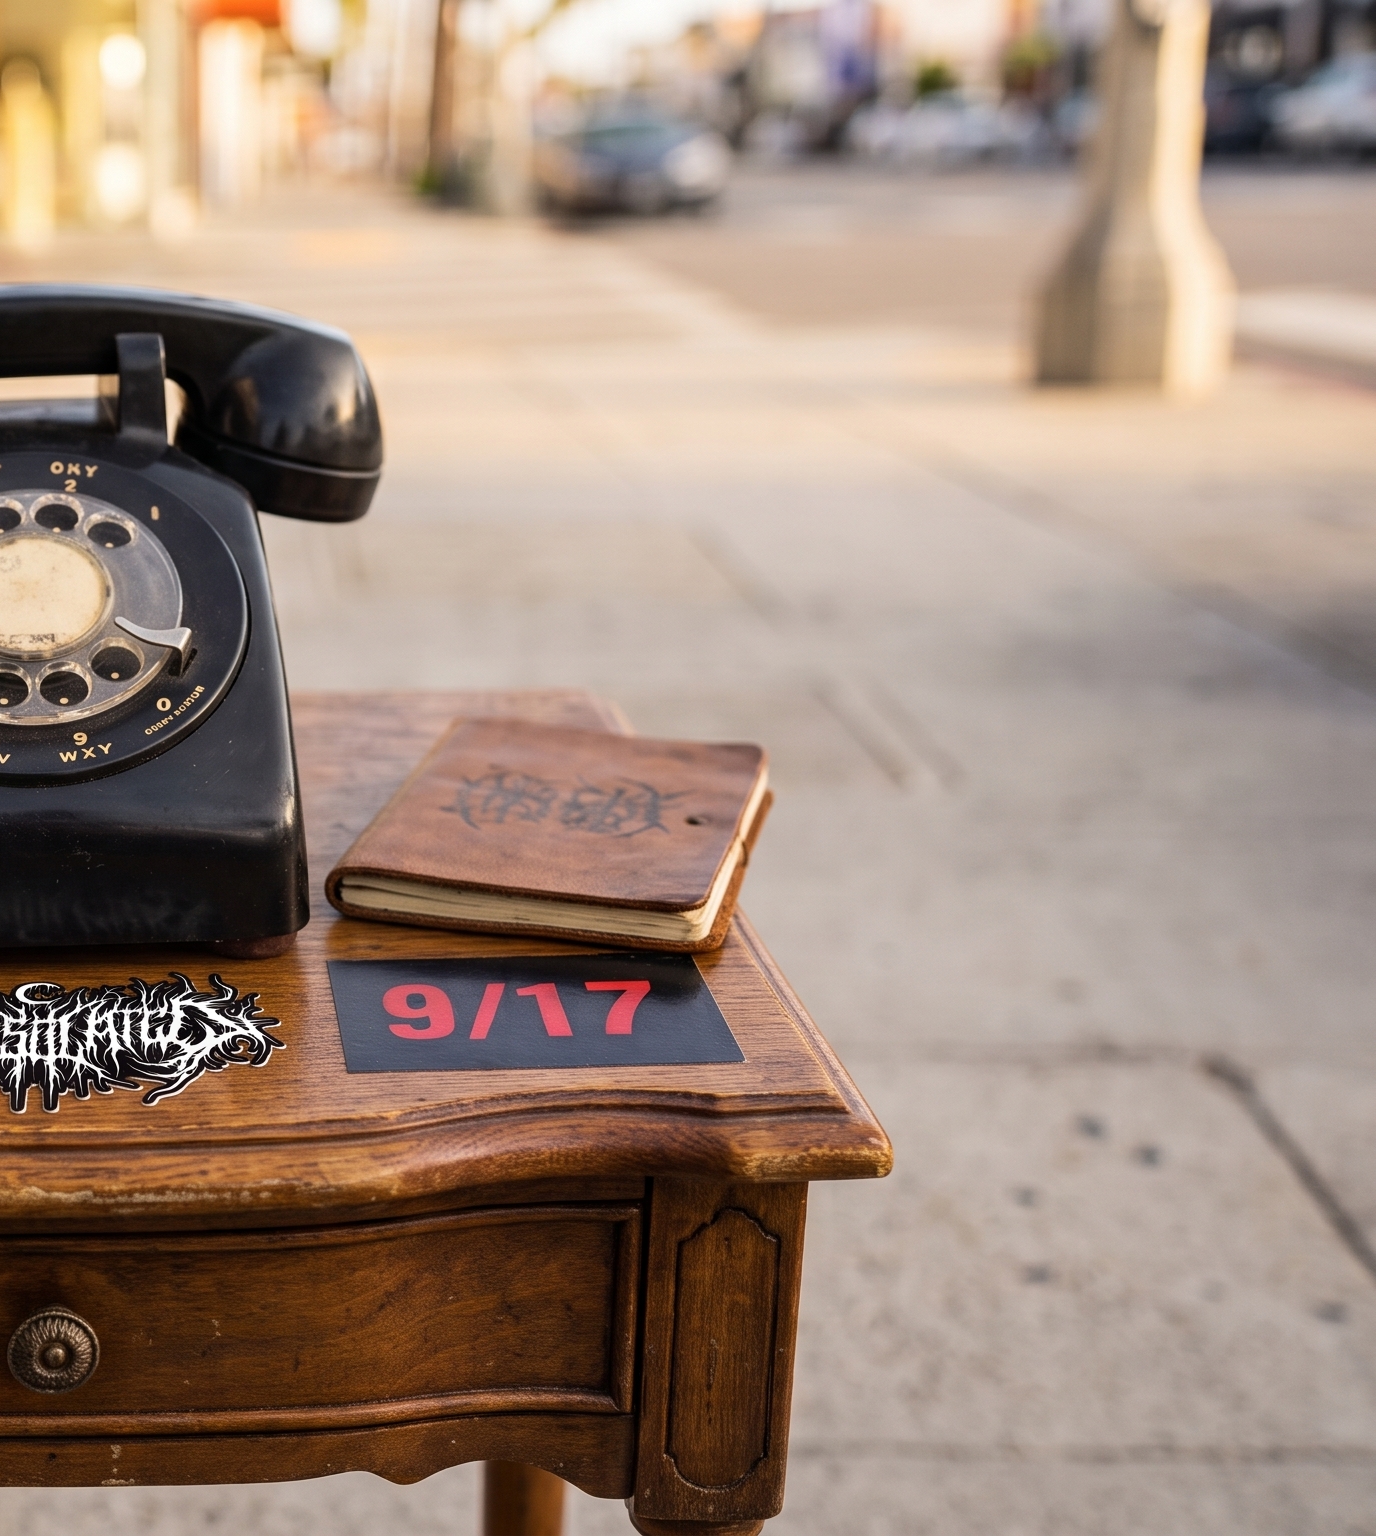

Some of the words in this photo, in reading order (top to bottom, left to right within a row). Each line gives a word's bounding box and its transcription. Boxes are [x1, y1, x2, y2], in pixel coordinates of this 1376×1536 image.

[64, 479, 77, 493] 2
[73, 732, 88, 746] 9
[59, 742, 112, 763] WXY
[382, 980, 651, 1040] 9/17
